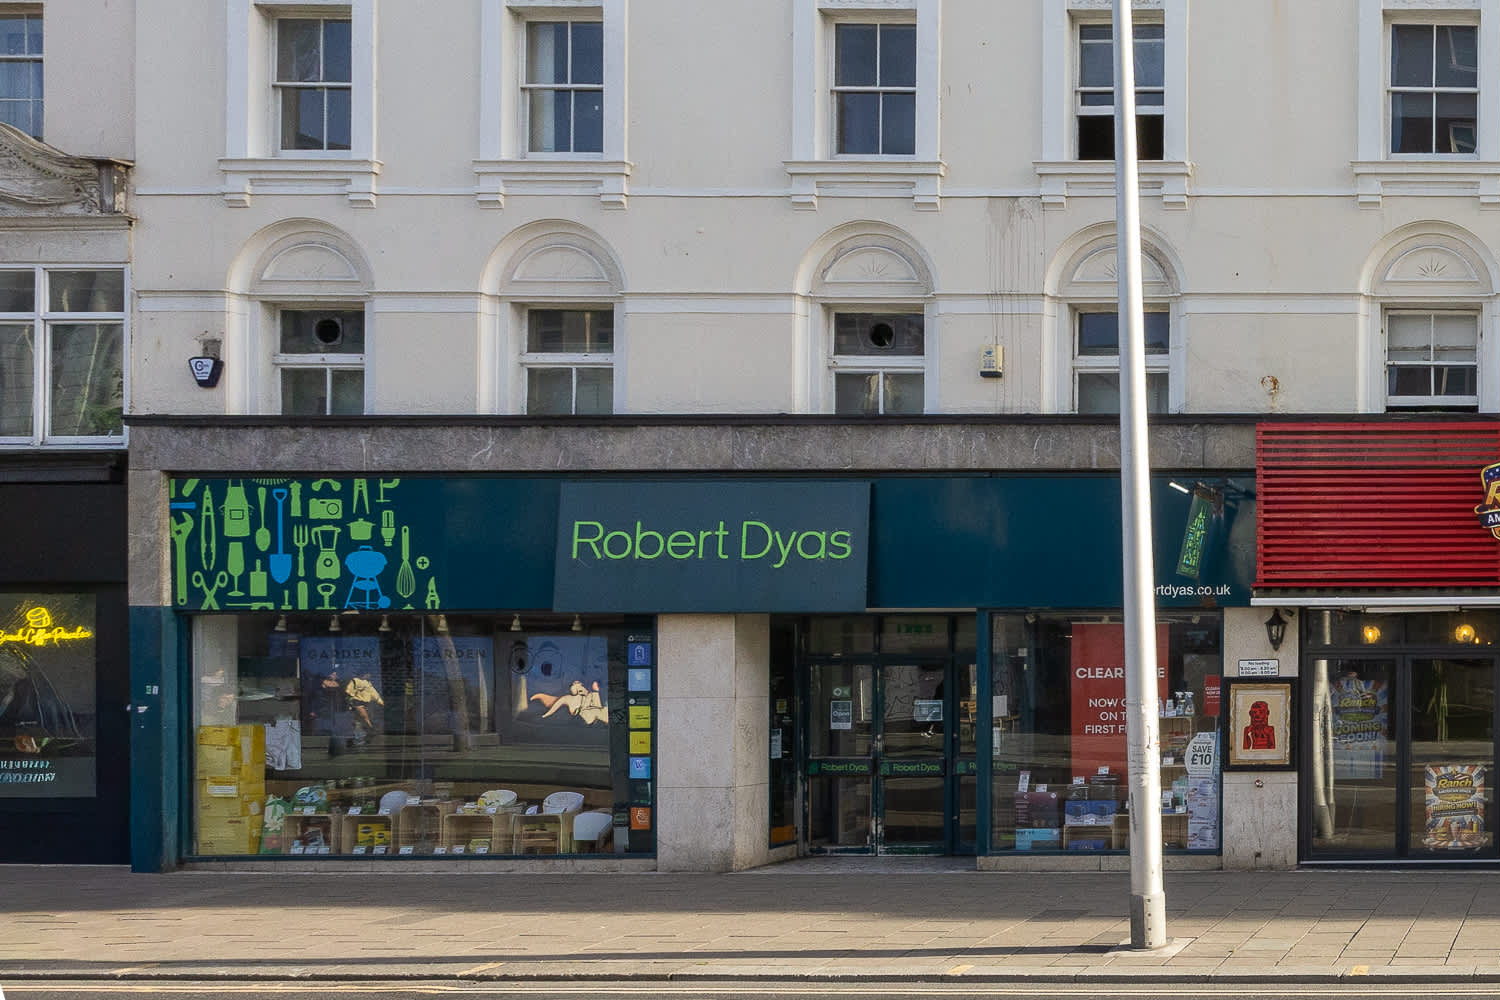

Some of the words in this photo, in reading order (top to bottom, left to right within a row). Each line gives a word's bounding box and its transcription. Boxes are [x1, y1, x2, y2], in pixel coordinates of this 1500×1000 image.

[572, 520, 729, 560] Robert
[740, 520, 852, 569] Dyas
[1153, 584, 1231, 598] rtdyas.co.uk
[310, 648, 373, 659] GARDEN
[1076, 667, 1165, 679] CLEARE
[1088, 698, 1118, 708] NOW
[1099, 711, 1117, 721] ON
[1084, 724, 1116, 734] FIRST
[1191, 745, 1213, 754] SAVE
[1191, 754, 1212, 766] £10
[821, 763, 848, 771] Robert
[848, 763, 869, 772] Dyas
[893, 763, 919, 771] Robert
[920, 763, 940, 772] Dyas
[1438, 778, 1473, 789] Ranch
